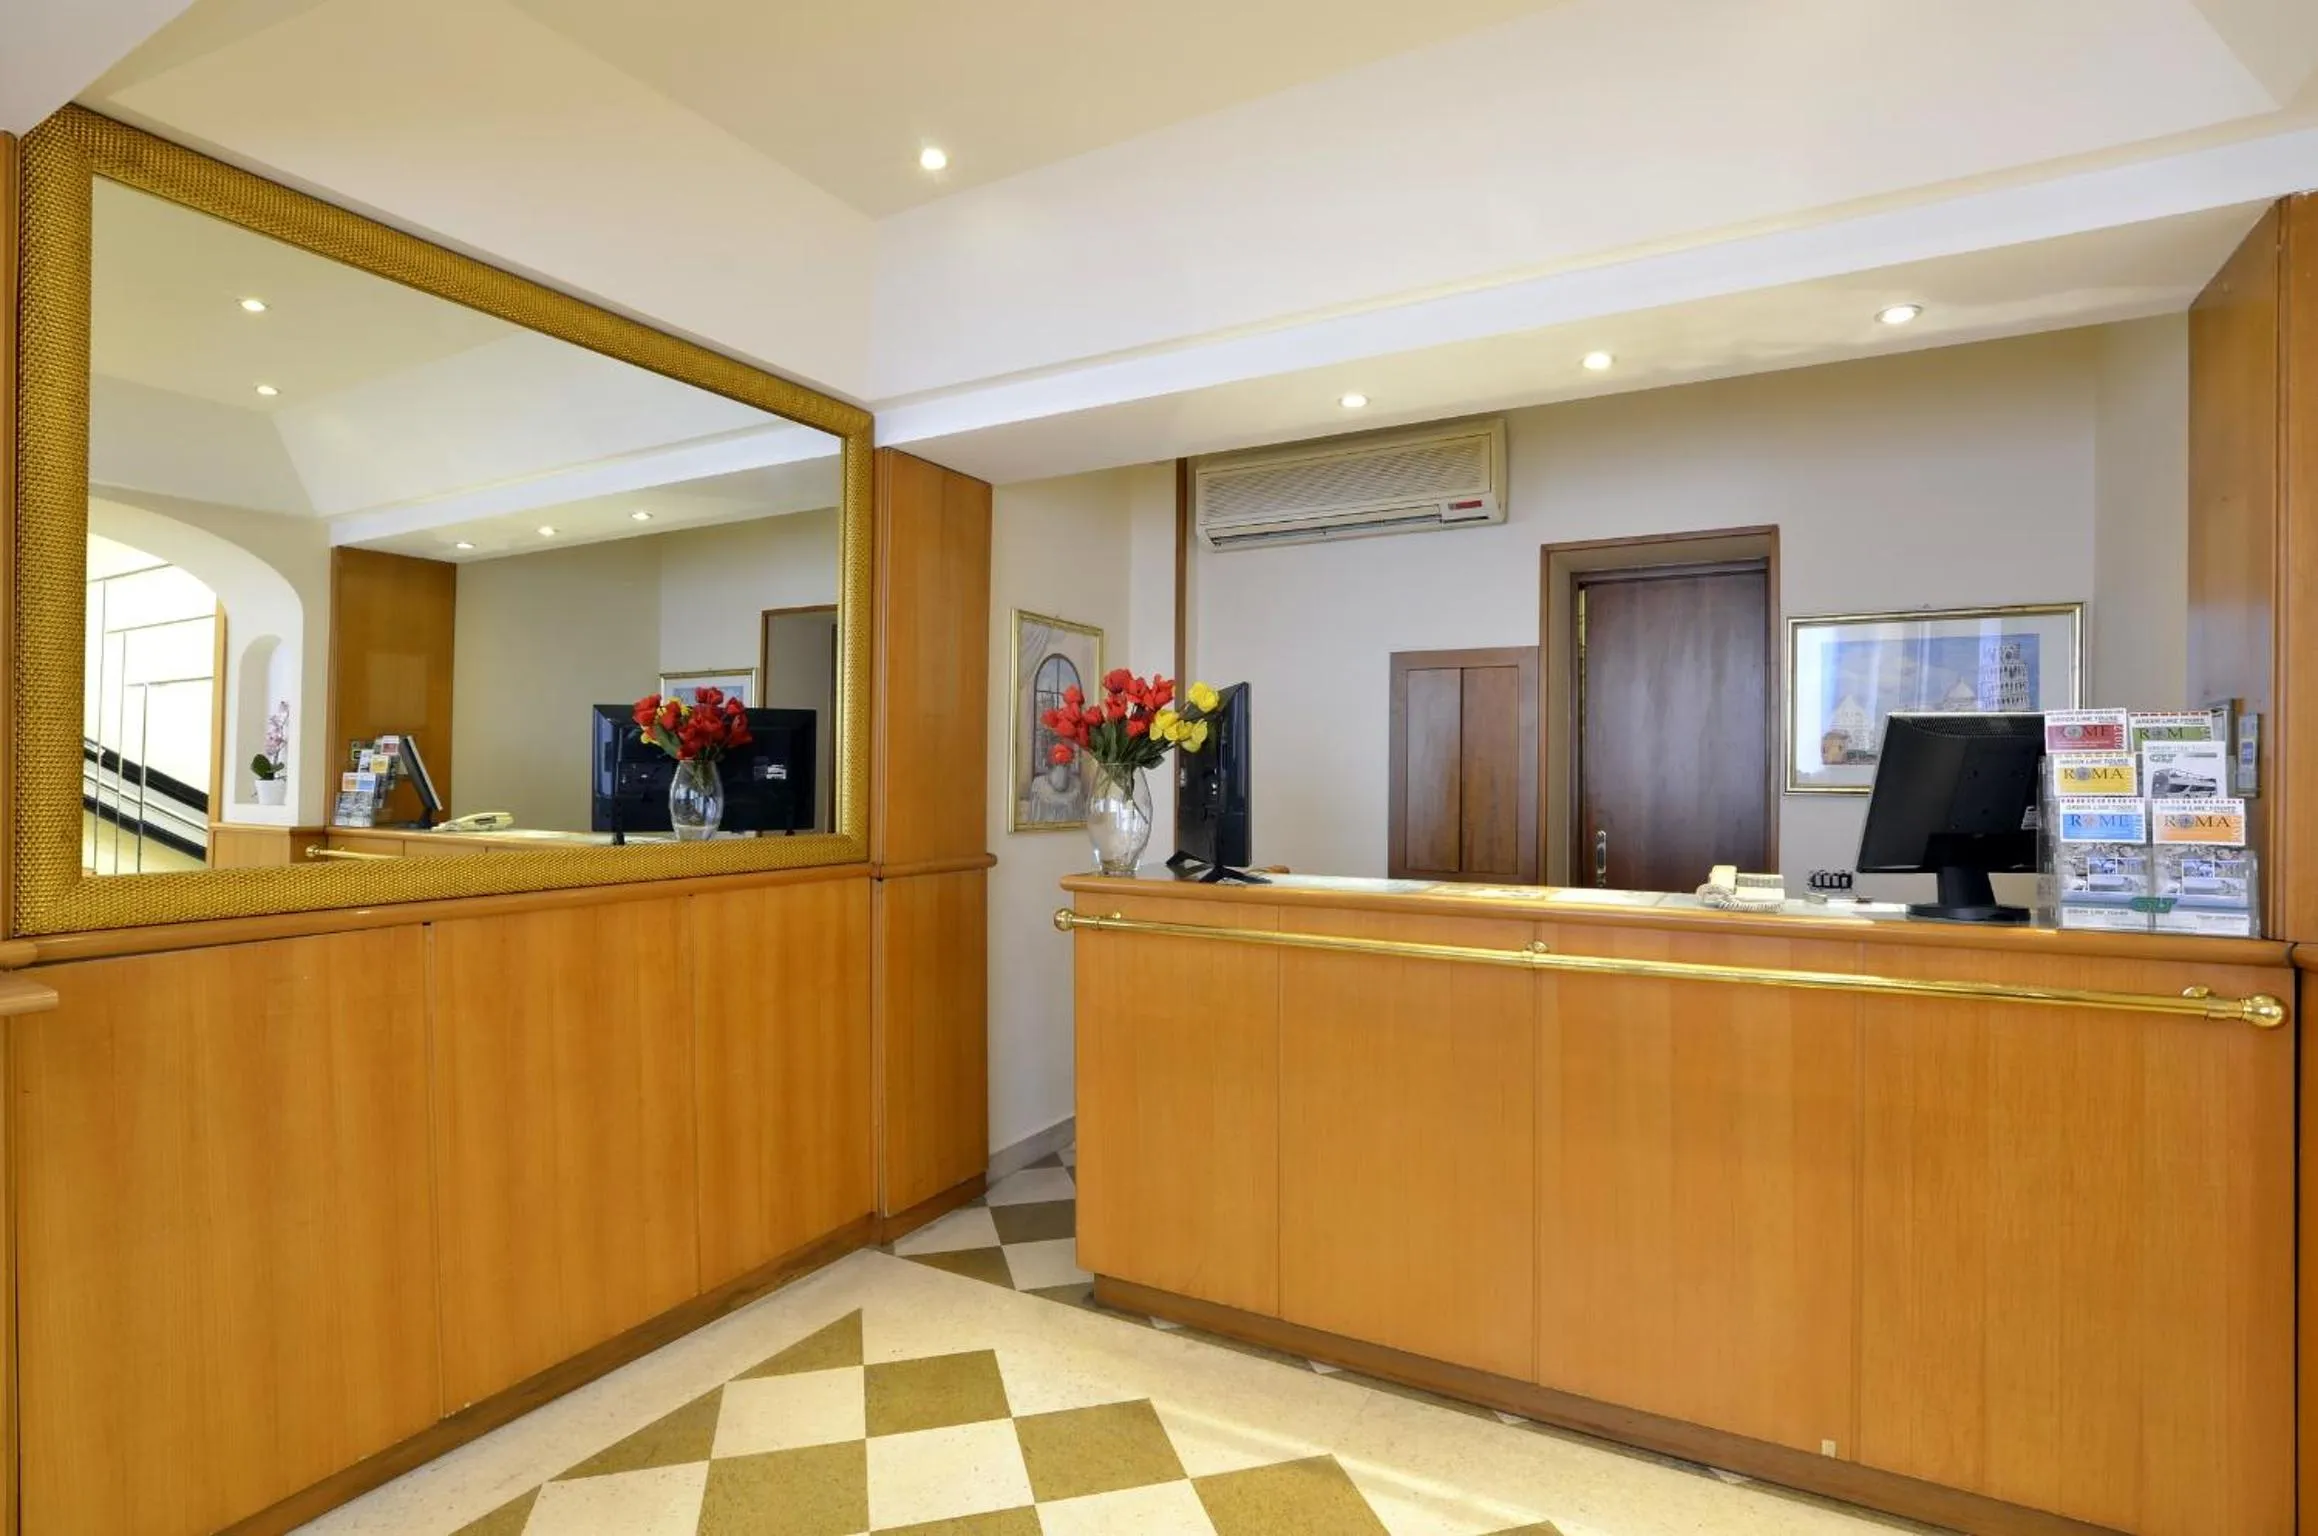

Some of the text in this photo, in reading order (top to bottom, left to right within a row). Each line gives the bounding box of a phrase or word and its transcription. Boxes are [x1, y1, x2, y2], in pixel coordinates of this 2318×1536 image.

[2064, 767, 2124, 781] ROMA
[2070, 814, 2130, 828] ROME
[2164, 814, 2231, 829] ROMA
